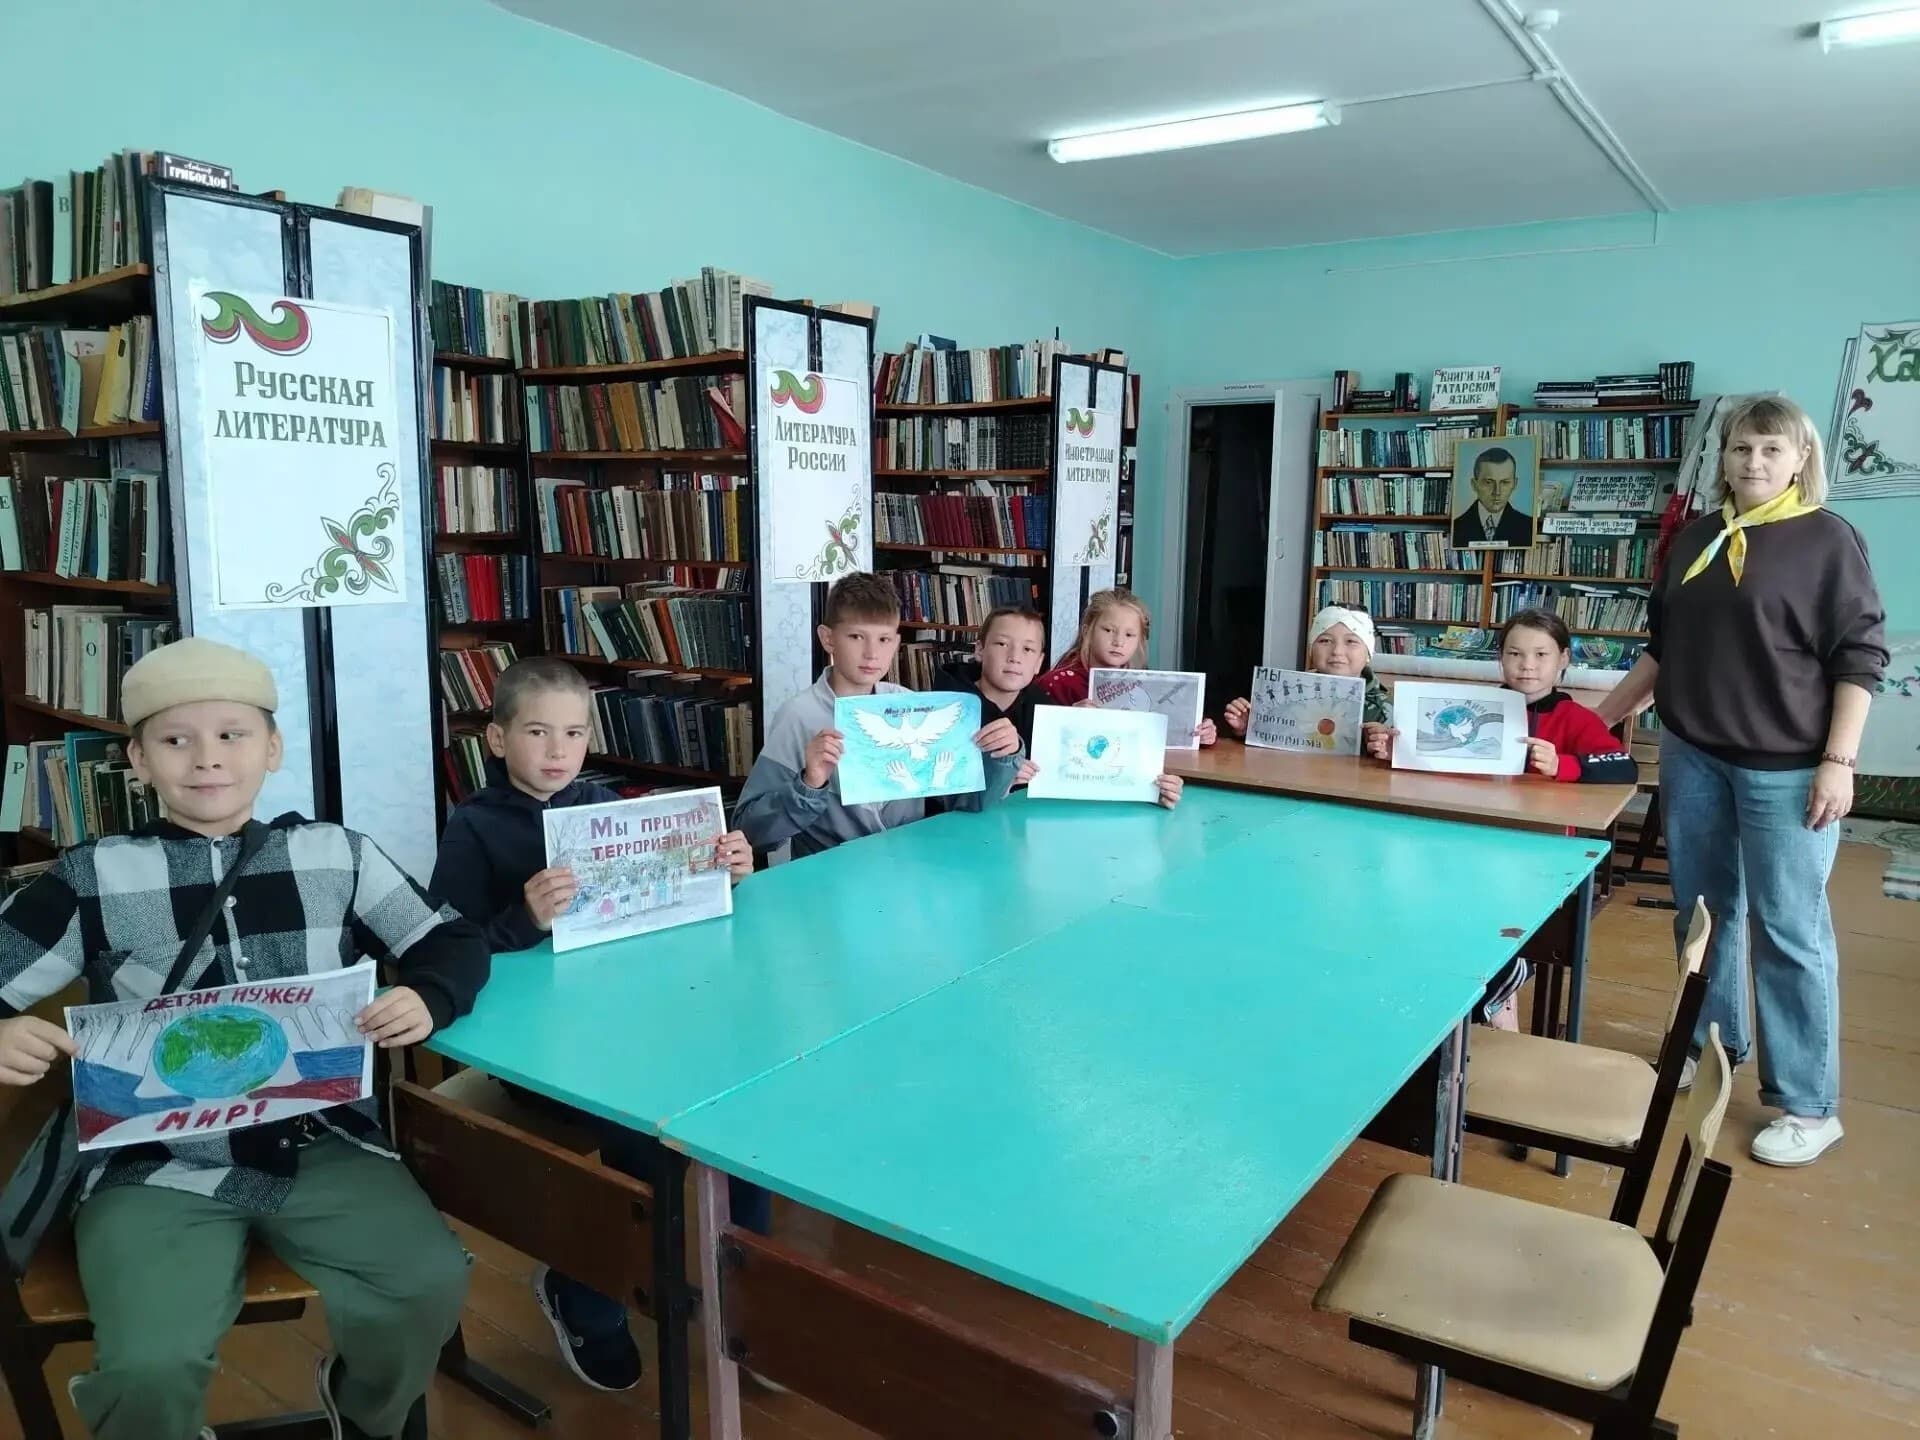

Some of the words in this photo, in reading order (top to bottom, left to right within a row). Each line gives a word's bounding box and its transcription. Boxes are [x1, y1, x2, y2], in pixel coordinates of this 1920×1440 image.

[58, 196, 70, 213] В
[1867, 341, 1920, 384] Ха
[1478, 370, 1490, 381] НА
[1436, 382, 1496, 394] ТАТАРСКОМ
[1449, 394, 1483, 404] ЯЗЫКЕ
[213, 409, 388, 448] ЛИТЕРАТУРА
[775, 416, 857, 446] ЛИТЕРАТУРА
[1066, 467, 1111, 483] ЛИТЕРАТУРА
[12, 761, 25, 774] Р
[232, 986, 314, 1004] НУЖЕН
[155, 1099, 269, 1132] МИР!
